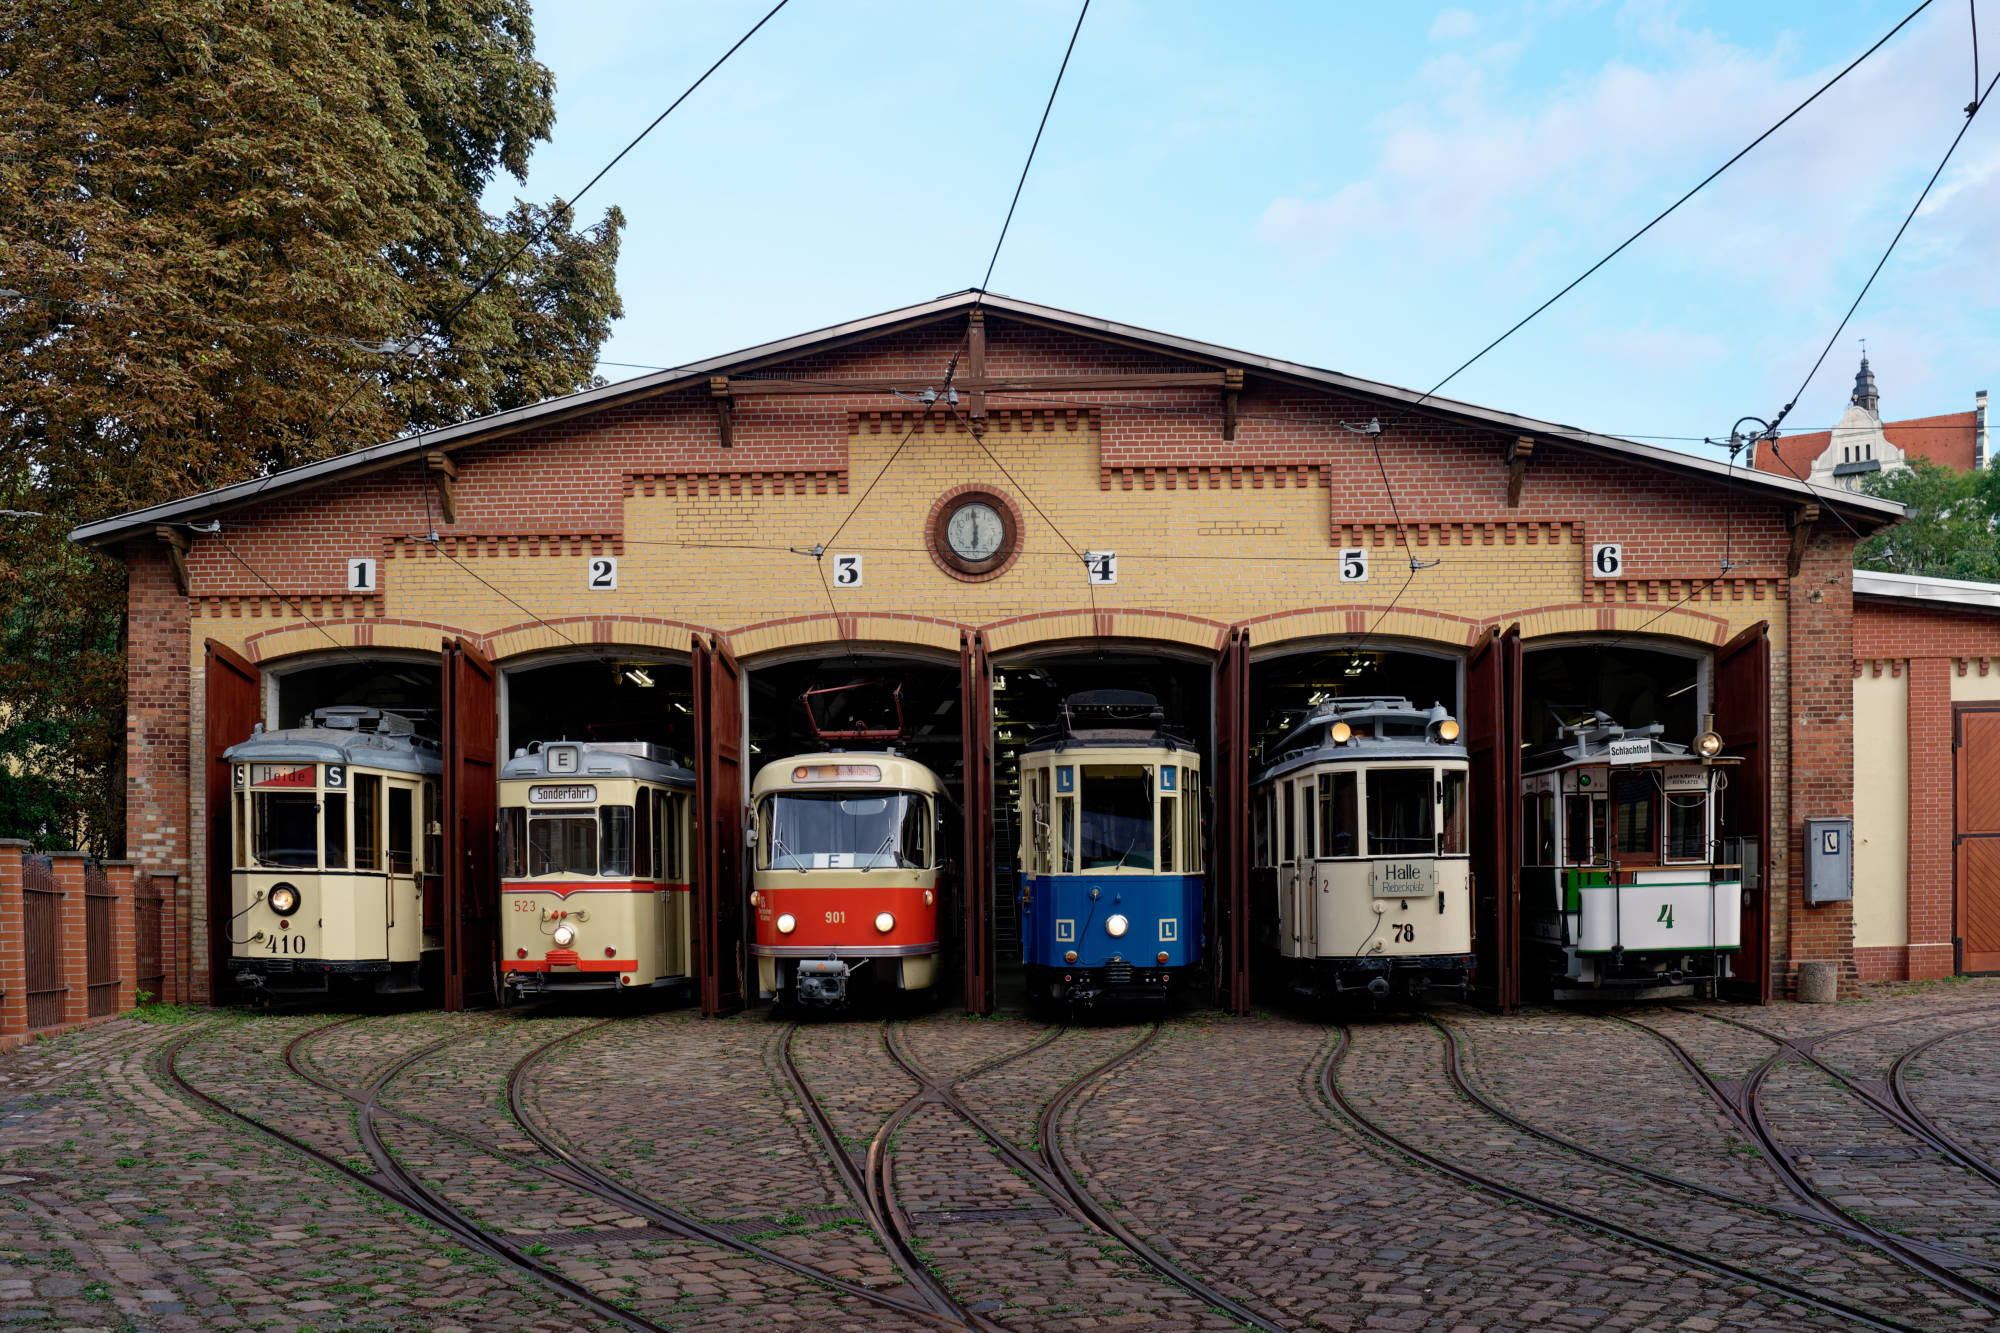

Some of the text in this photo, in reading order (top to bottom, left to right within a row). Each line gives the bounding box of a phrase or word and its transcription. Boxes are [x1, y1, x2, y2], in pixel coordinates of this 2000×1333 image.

[1091, 554, 1114, 581] 4
[1344, 550, 1364, 579] 5
[1597, 546, 1618, 574] 6
[354, 562, 370, 588] 1
[592, 560, 613, 587] 2
[838, 557, 858, 584] 3
[1611, 744, 1650, 756] Schlachthof
[558, 752, 568, 767] E
[237, 765, 245, 785] S
[263, 766, 305, 783] Heide
[328, 766, 342, 786] S
[1062, 770, 1070, 786] L
[1163, 770, 1171, 786] L
[537, 785, 591, 800] Sonderfahrt
[1385, 864, 1421, 880] Halle
[1323, 879, 1330, 893] 2
[1382, 881, 1425, 893] Riebeckplatz
[513, 900, 537, 913] 523
[825, 911, 846, 924] 901
[1656, 903, 1675, 929] 4
[1060, 924, 1068, 937] L
[1165, 923, 1174, 937] L
[1392, 923, 1415, 943] 78
[264, 934, 306, 954] 410
